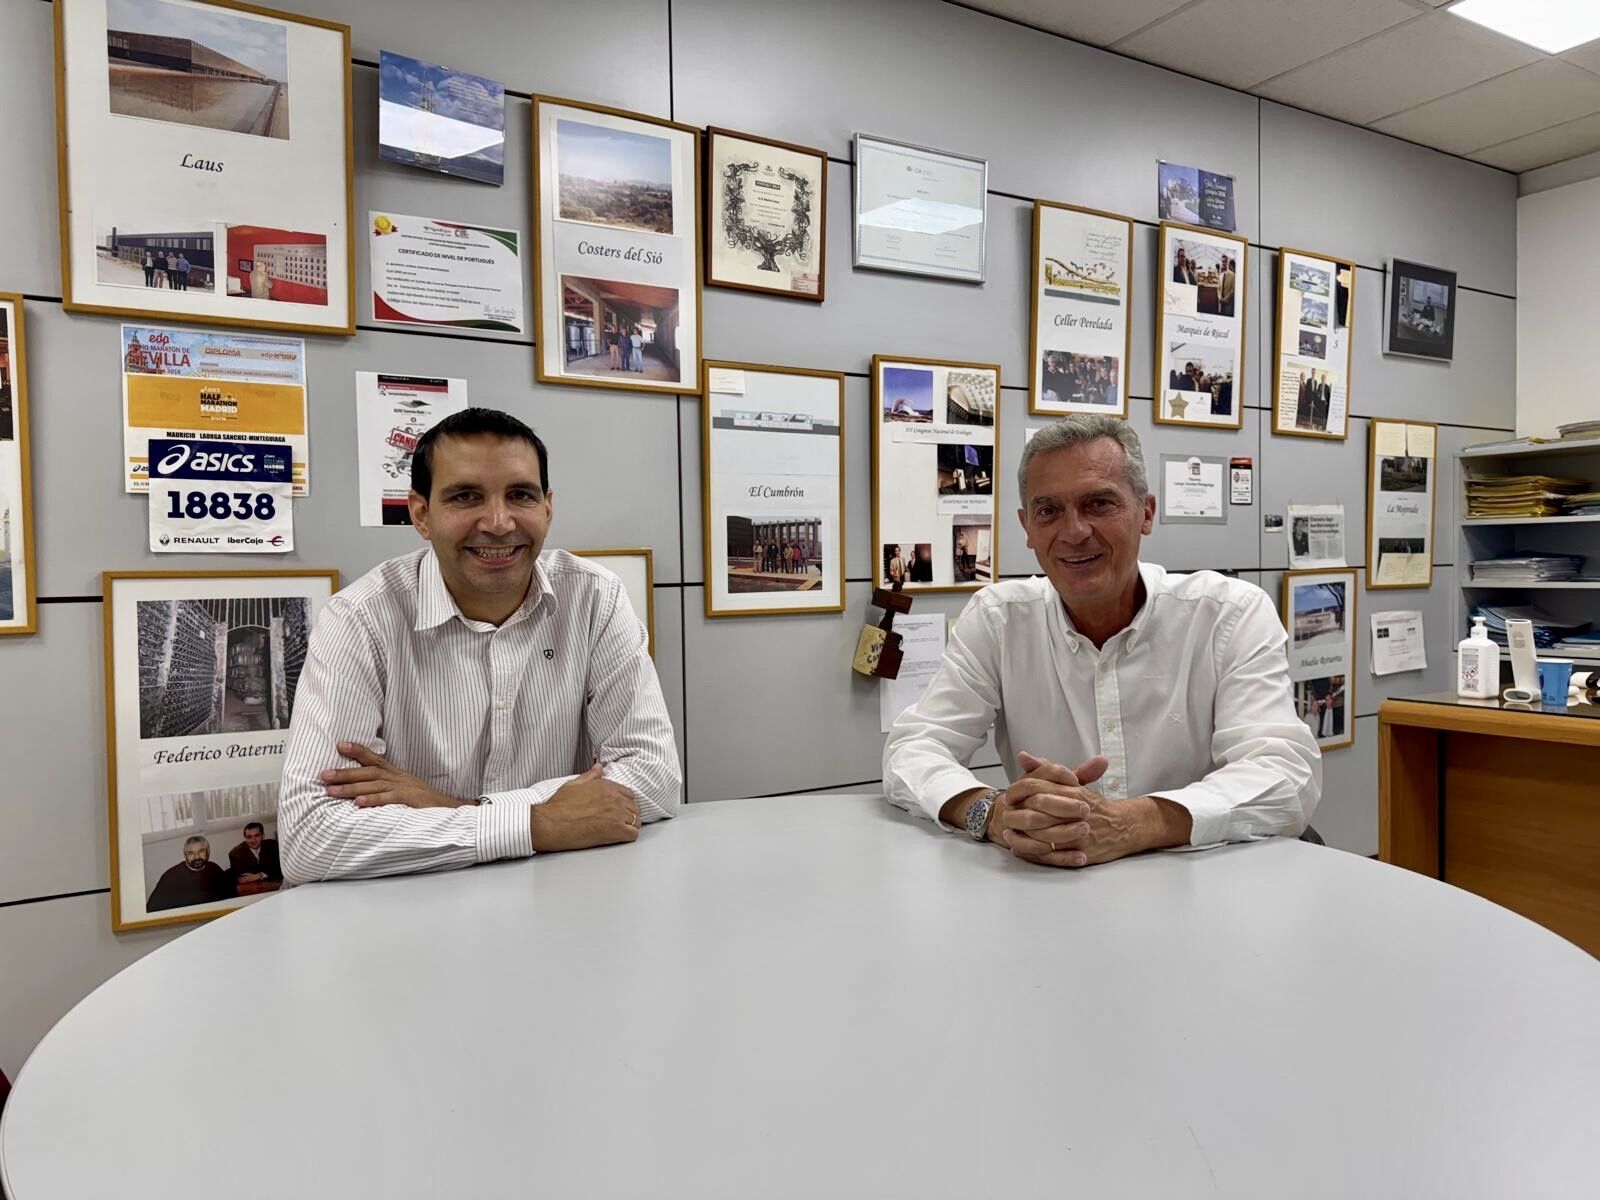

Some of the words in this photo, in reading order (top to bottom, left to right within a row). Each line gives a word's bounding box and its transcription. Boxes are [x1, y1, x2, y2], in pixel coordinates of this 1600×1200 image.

[180, 153, 224, 173] Laus
[398, 248, 434, 258] CERTIFICADO
[442, 253, 456, 261] NIVEL
[577, 240, 621, 259] Costers
[624, 246, 644, 262] del
[643, 251, 663, 265] Sió
[1054, 313, 1078, 328] Celler
[1079, 316, 1113, 331] Perelada
[1202, 326, 1210, 336] de
[149, 332, 170, 346] edp
[181, 346, 190, 354] DE
[204, 347, 241, 358] DIPLOMA
[128, 350, 191, 368] SEVILLA
[200, 405, 238, 413] MADRID
[166, 431, 196, 439] MAURICIO
[190, 451, 256, 473] asics
[748, 485, 762, 498] El
[763, 486, 804, 499] Cumbrón
[167, 490, 276, 520] 18838
[153, 746, 222, 764] Federico
